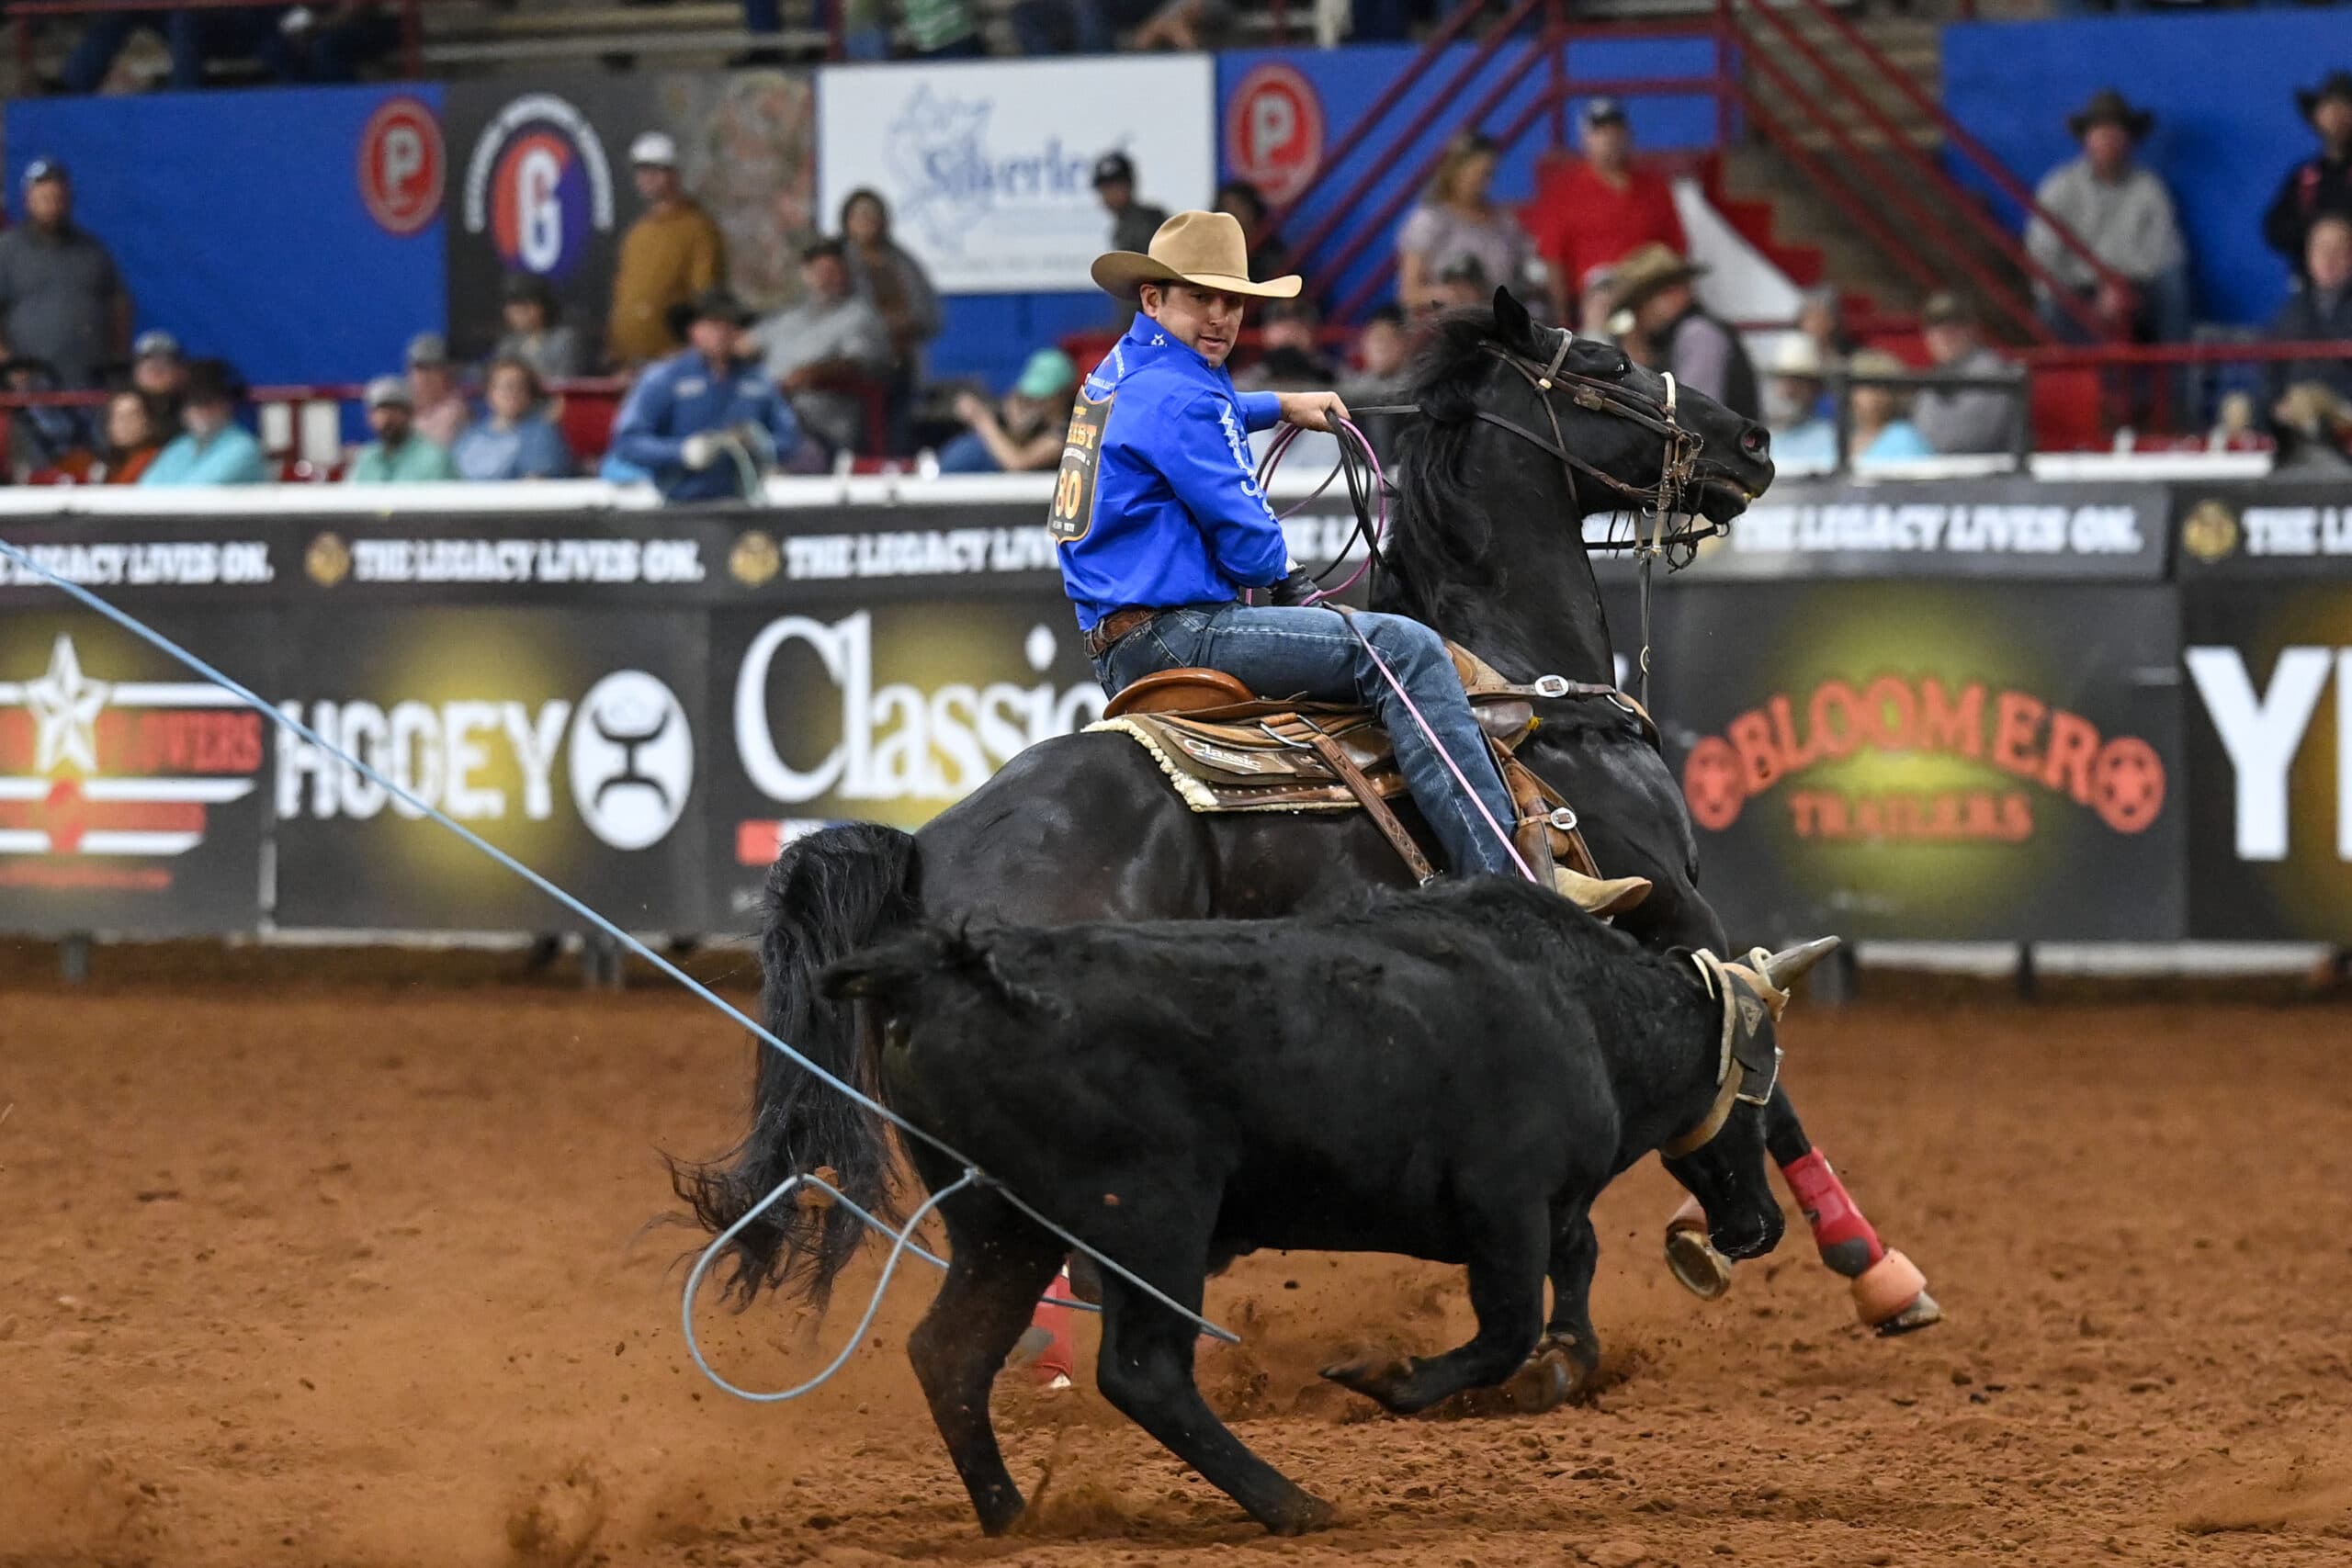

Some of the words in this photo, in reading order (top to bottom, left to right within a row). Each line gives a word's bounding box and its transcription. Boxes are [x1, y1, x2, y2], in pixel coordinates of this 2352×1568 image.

[1055, 467, 1082, 520] 80
[784, 535, 854, 580] THE
[856, 528, 988, 577] LEGACY
[1946, 504, 2069, 553] LIVES
[2240, 505, 2317, 557] THE
[128, 542, 219, 584] LIVES
[353, 539, 414, 581] THE
[416, 538, 535, 581] LEGACY
[537, 538, 642, 581] LIVES
[645, 538, 707, 582] ON.
[277, 699, 572, 819] HOOEY
[1183, 739, 1262, 769] Classic
[1728, 674, 2102, 805] BLOOMER
[2183, 645, 2352, 862] Y
